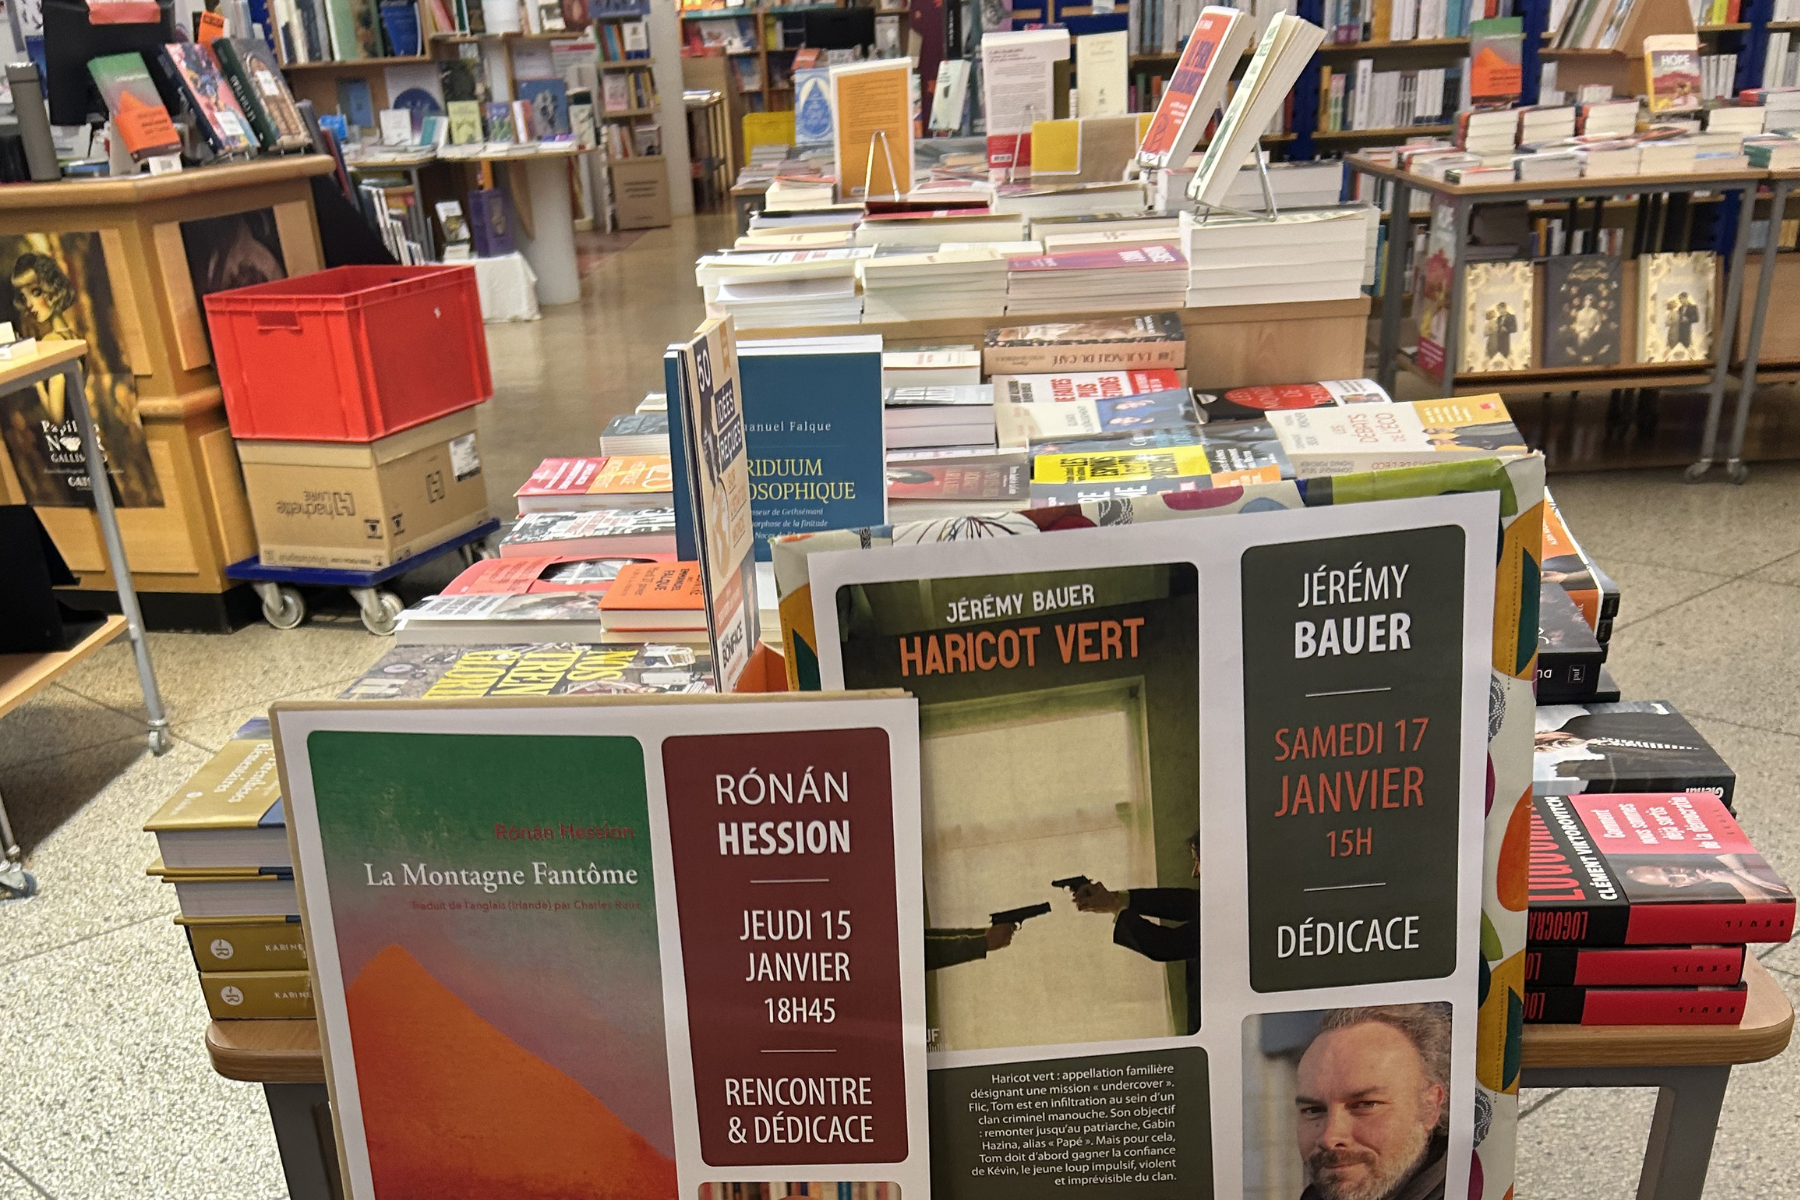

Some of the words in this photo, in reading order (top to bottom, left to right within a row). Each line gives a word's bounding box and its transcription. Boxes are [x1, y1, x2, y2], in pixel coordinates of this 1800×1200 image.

[1661, 54, 1690, 65] HOPE
[697, 349, 711, 393] 50
[716, 388, 734, 425] IDÉES
[719, 419, 742, 464] REÇUES
[744, 421, 784, 432] manuel
[790, 421, 831, 433] Falque
[1348, 413, 1379, 443] DÉBATS
[747, 458, 823, 476] RIDUUM
[750, 482, 856, 503] OSOPHIQUE
[800, 519, 827, 528] finitude
[654, 570, 676, 591] FALQUE
[1298, 562, 1409, 608] JÉRÉMY
[946, 594, 1023, 623] JÉRÉMY
[1033, 584, 1095, 612] BAUER
[900, 626, 1041, 677] HARICOT
[1055, 617, 1145, 664] VERT
[1294, 612, 1411, 659] BAUER
[421, 651, 521, 699] GLORI
[491, 650, 583, 695] TREN
[567, 649, 639, 681] NOS
[1274, 720, 1383, 762] SAMEDI
[1394, 717, 1430, 753] 17
[716, 766, 849, 805] RÓNÁN
[1274, 765, 1424, 817] JANVIER
[494, 821, 553, 841] Rónán
[559, 821, 634, 840] Hession
[1544, 797, 1593, 855] VIKTOROVITCH
[1591, 809, 1626, 839] Comment
[1619, 803, 1647, 829] sommes
[1649, 807, 1674, 826] sortis
[1668, 796, 1709, 835] démocratie
[718, 820, 850, 856] HESSION
[1325, 827, 1373, 858] 15H
[1635, 829, 1660, 845] nous
[1659, 825, 1685, 841] déjà
[1692, 833, 1714, 841] la
[364, 863, 395, 886] La
[401, 863, 525, 893] Montagne
[532, 861, 638, 885] Fantôme
[1582, 855, 1618, 900] CLÉMENT
[740, 909, 812, 941] JEUDI
[821, 910, 852, 940] 15
[1277, 915, 1420, 959] DÉDICACE
[1529, 911, 1588, 940] LOGOCRA
[1725, 920, 1785, 928] SEUIL
[265, 944, 304, 952] KARINE
[746, 952, 851, 982] JANVIER
[764, 998, 836, 1023] 18H45
[992, 1074, 1030, 1084] Haricot
[1033, 1073, 1055, 1081] vert
[1062, 1069, 1123, 1081] appellation
[1126, 1065, 1174, 1078] familière
[725, 1077, 872, 1106] RENCONTRE
[728, 1117, 748, 1144] &
[754, 1111, 874, 1144] DÉDICACE
